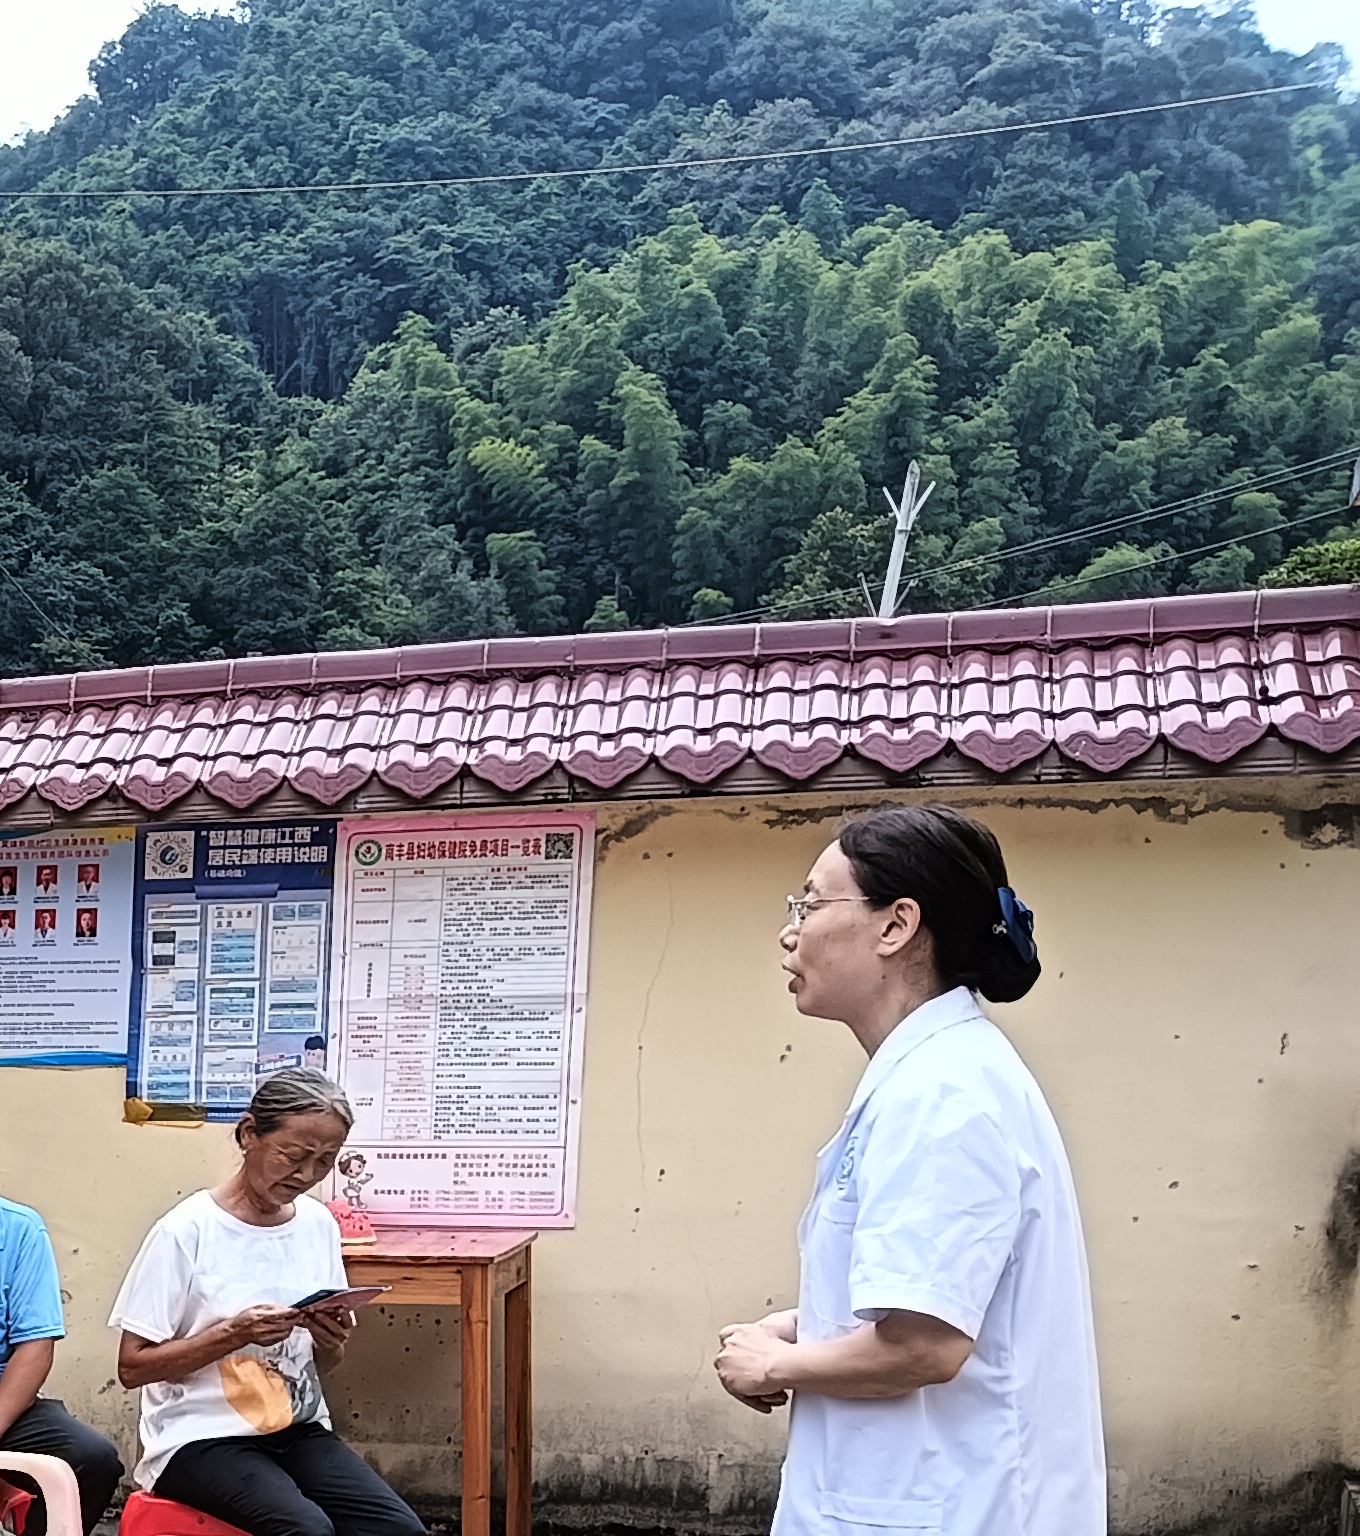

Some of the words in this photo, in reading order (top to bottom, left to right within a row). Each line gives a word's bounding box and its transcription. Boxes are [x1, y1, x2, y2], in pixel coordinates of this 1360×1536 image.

[207, 846, 328, 865] 居民端使用说明
[384, 837, 542, 861] 南丰县妇幼保健院免费项目一览表
